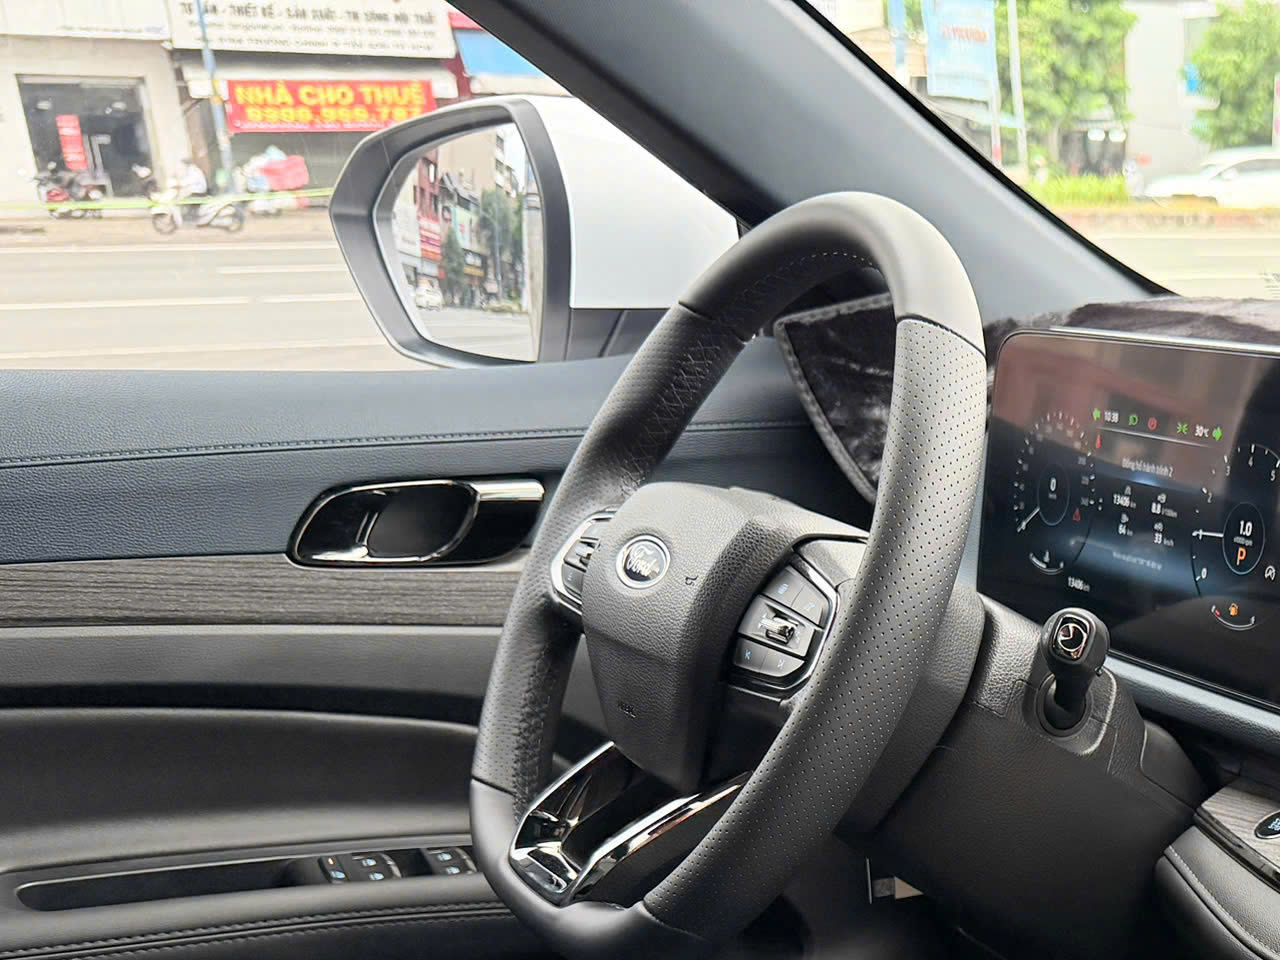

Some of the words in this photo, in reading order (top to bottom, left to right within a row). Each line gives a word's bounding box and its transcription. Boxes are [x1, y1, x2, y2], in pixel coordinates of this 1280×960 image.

[235, 81, 293, 105] NHÀ
[299, 85, 355, 106] CHO
[360, 83, 425, 105] THUÊ
[1050, 477, 1057, 492] 0
[1240, 520, 1252, 537] 1.0
[627, 544, 660, 577] Ford
[1236, 547, 1247, 566] P
